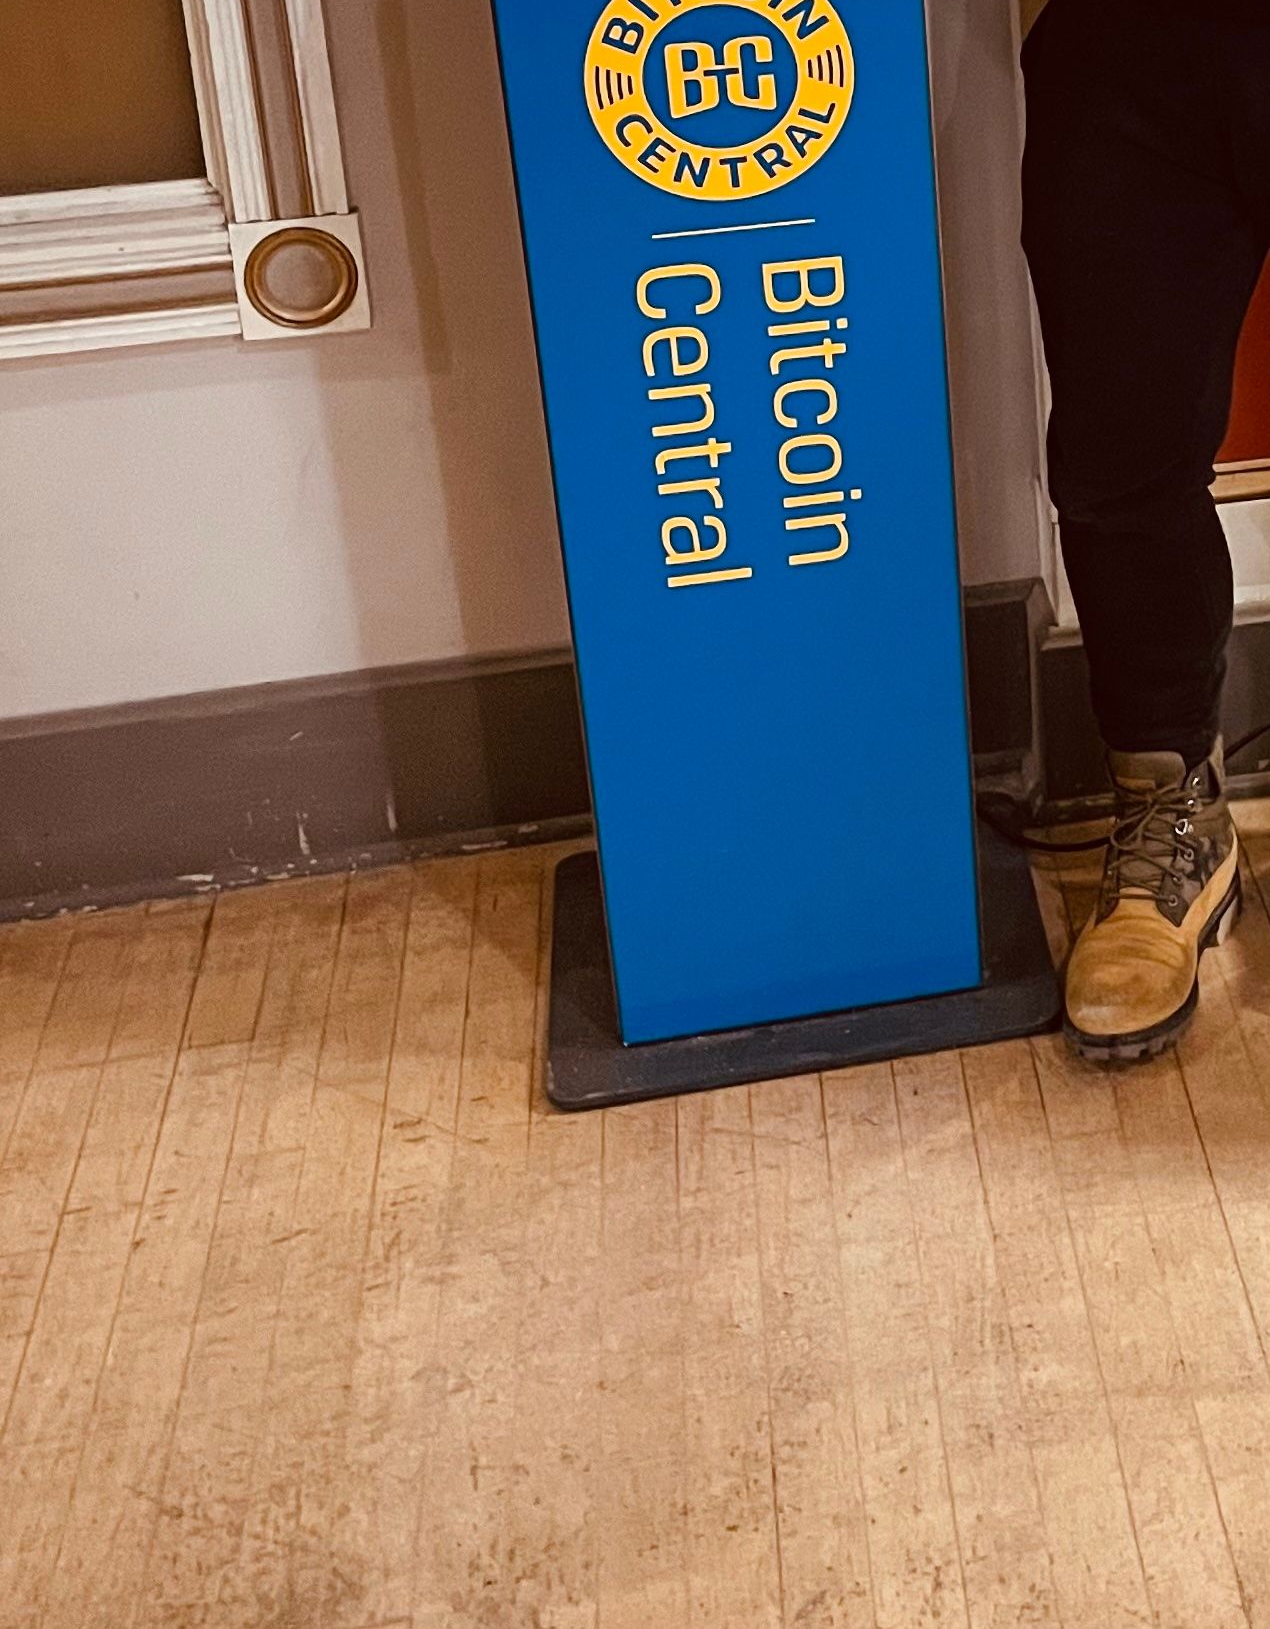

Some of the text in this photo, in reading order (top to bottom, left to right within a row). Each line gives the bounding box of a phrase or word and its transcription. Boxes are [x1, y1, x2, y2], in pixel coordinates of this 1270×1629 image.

[615, 101, 836, 189] CENTRAL
[636, 263, 753, 588] Central
[761, 256, 863, 566] Bitcoin
